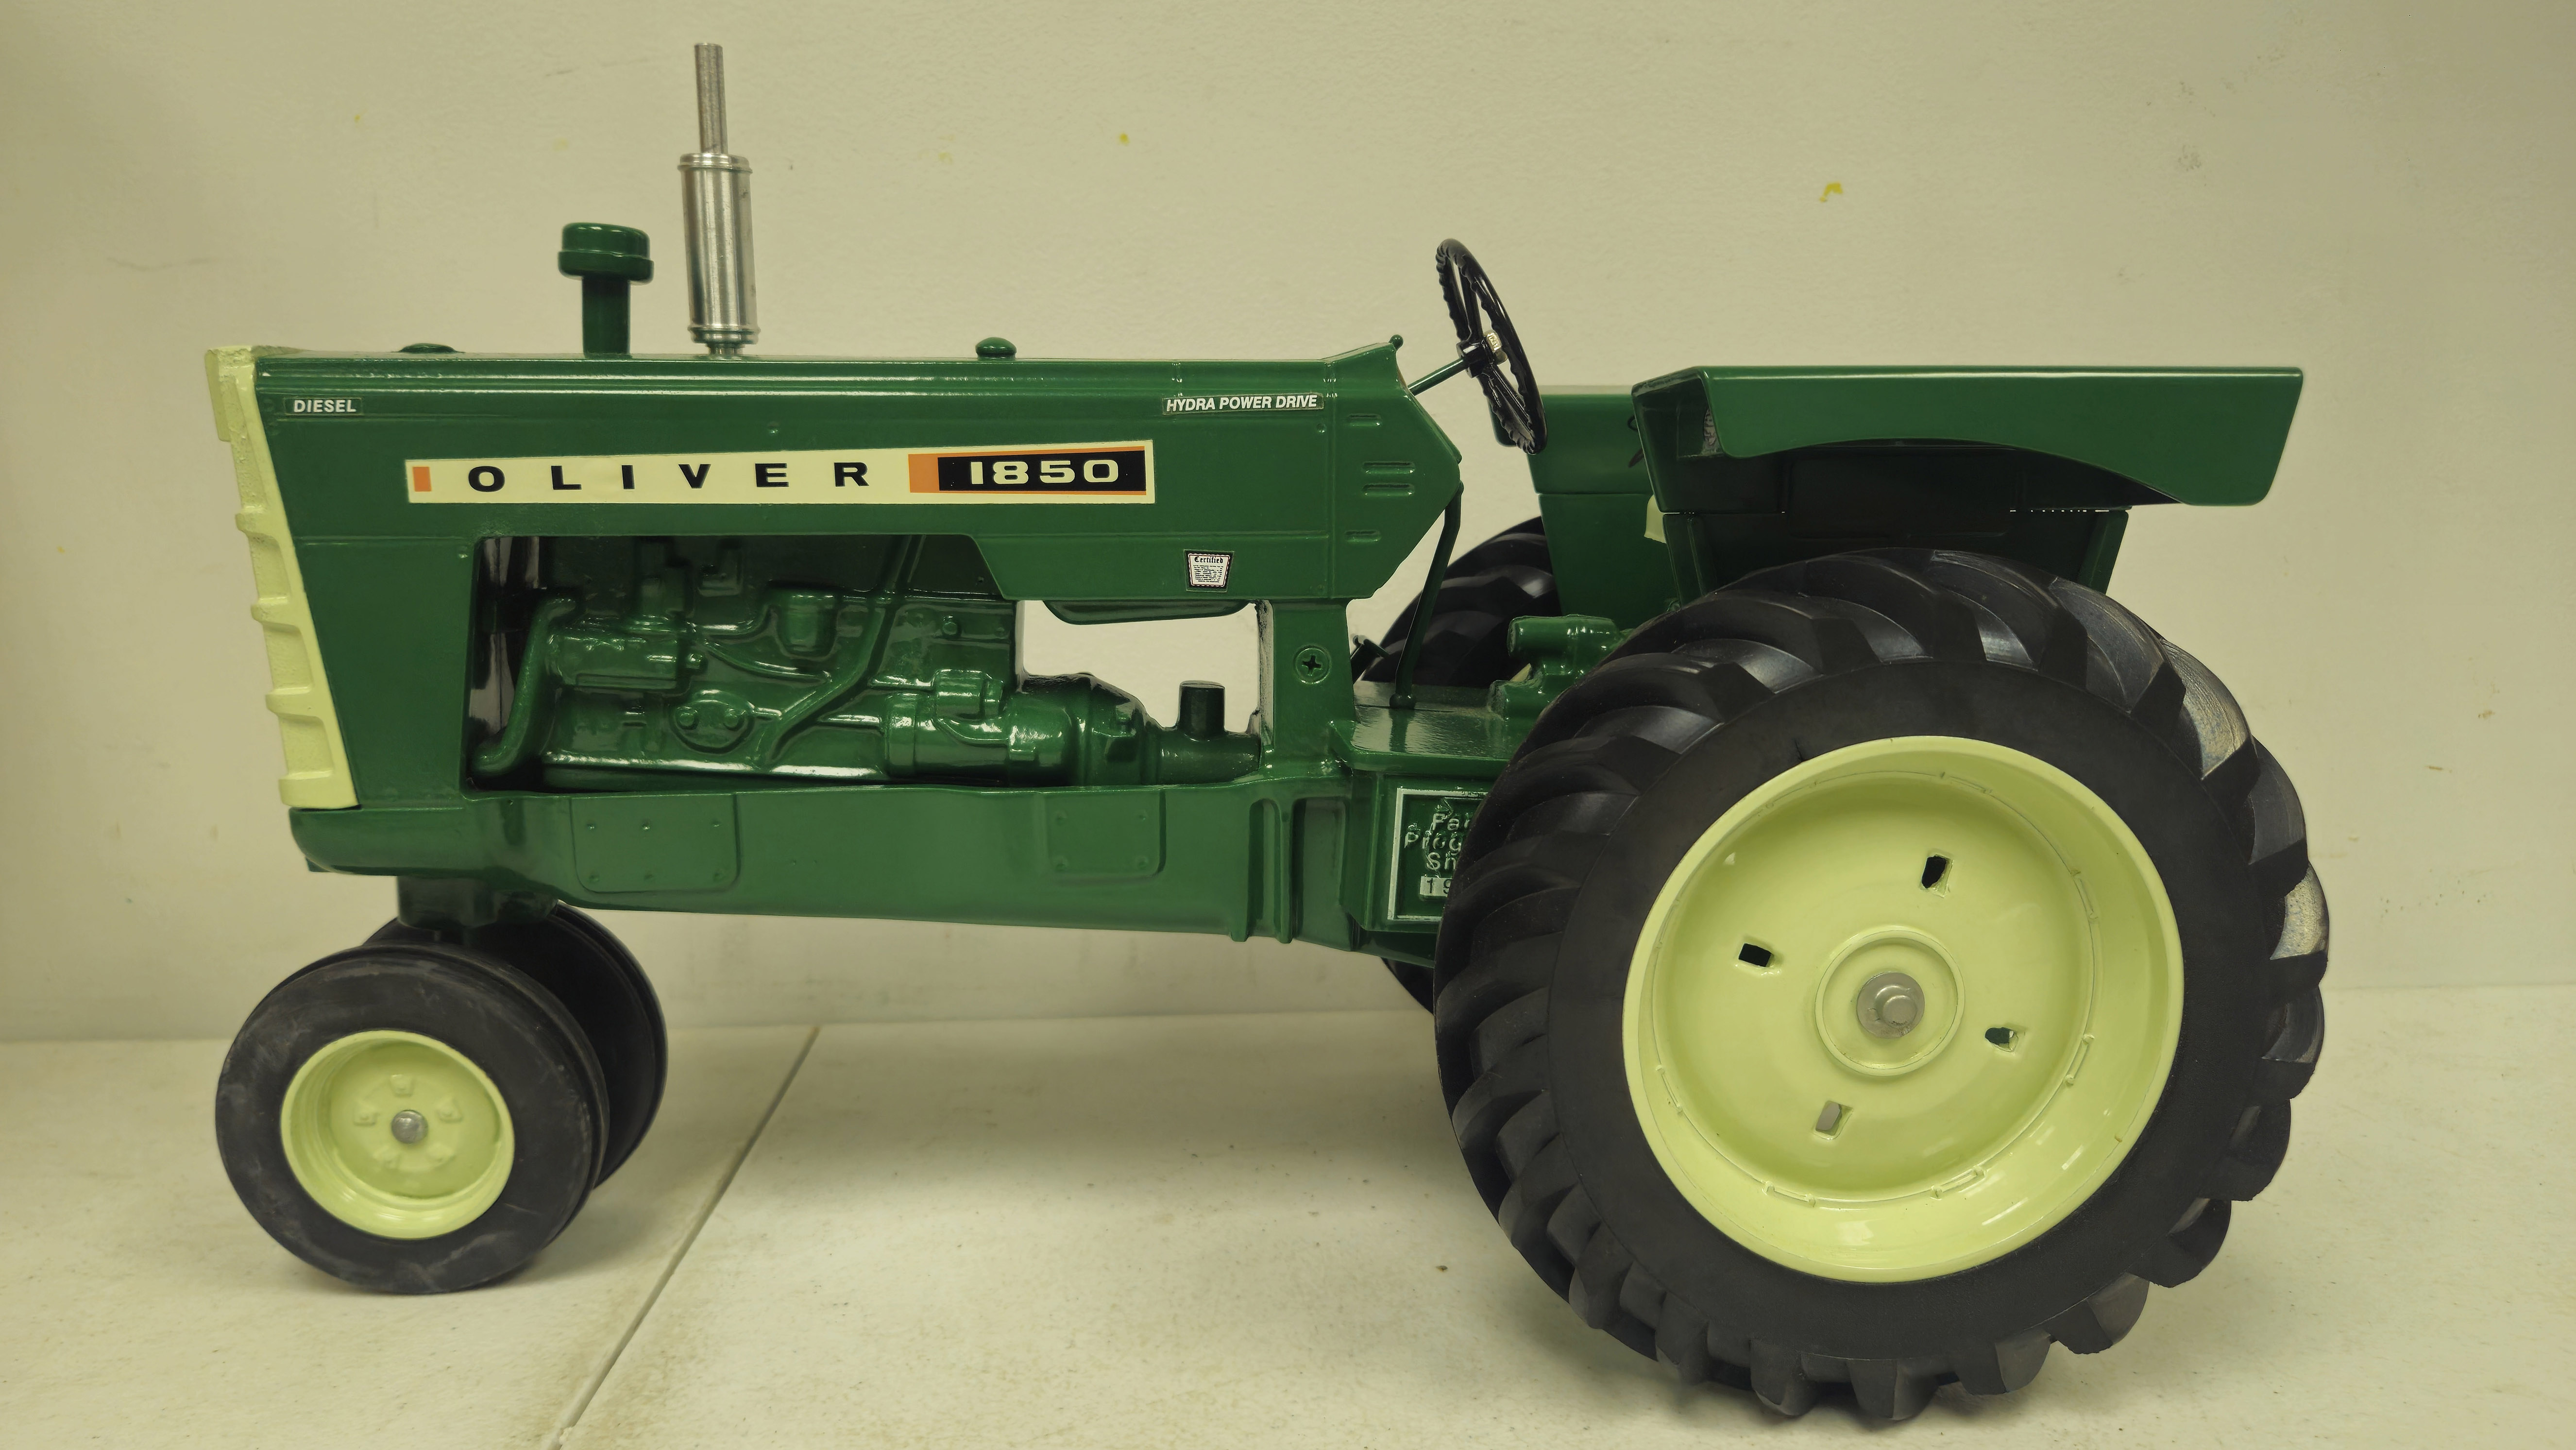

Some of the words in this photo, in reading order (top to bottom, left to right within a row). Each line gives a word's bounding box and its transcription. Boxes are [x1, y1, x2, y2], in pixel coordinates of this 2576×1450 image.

[293, 399, 356, 412] DIESEL
[1167, 397, 1215, 412] HYDRA
[1219, 396, 1271, 409] POWER
[1275, 395, 1318, 408] DRIVE
[468, 461, 870, 492] OLIVER
[970, 459, 1119, 485] 1850
